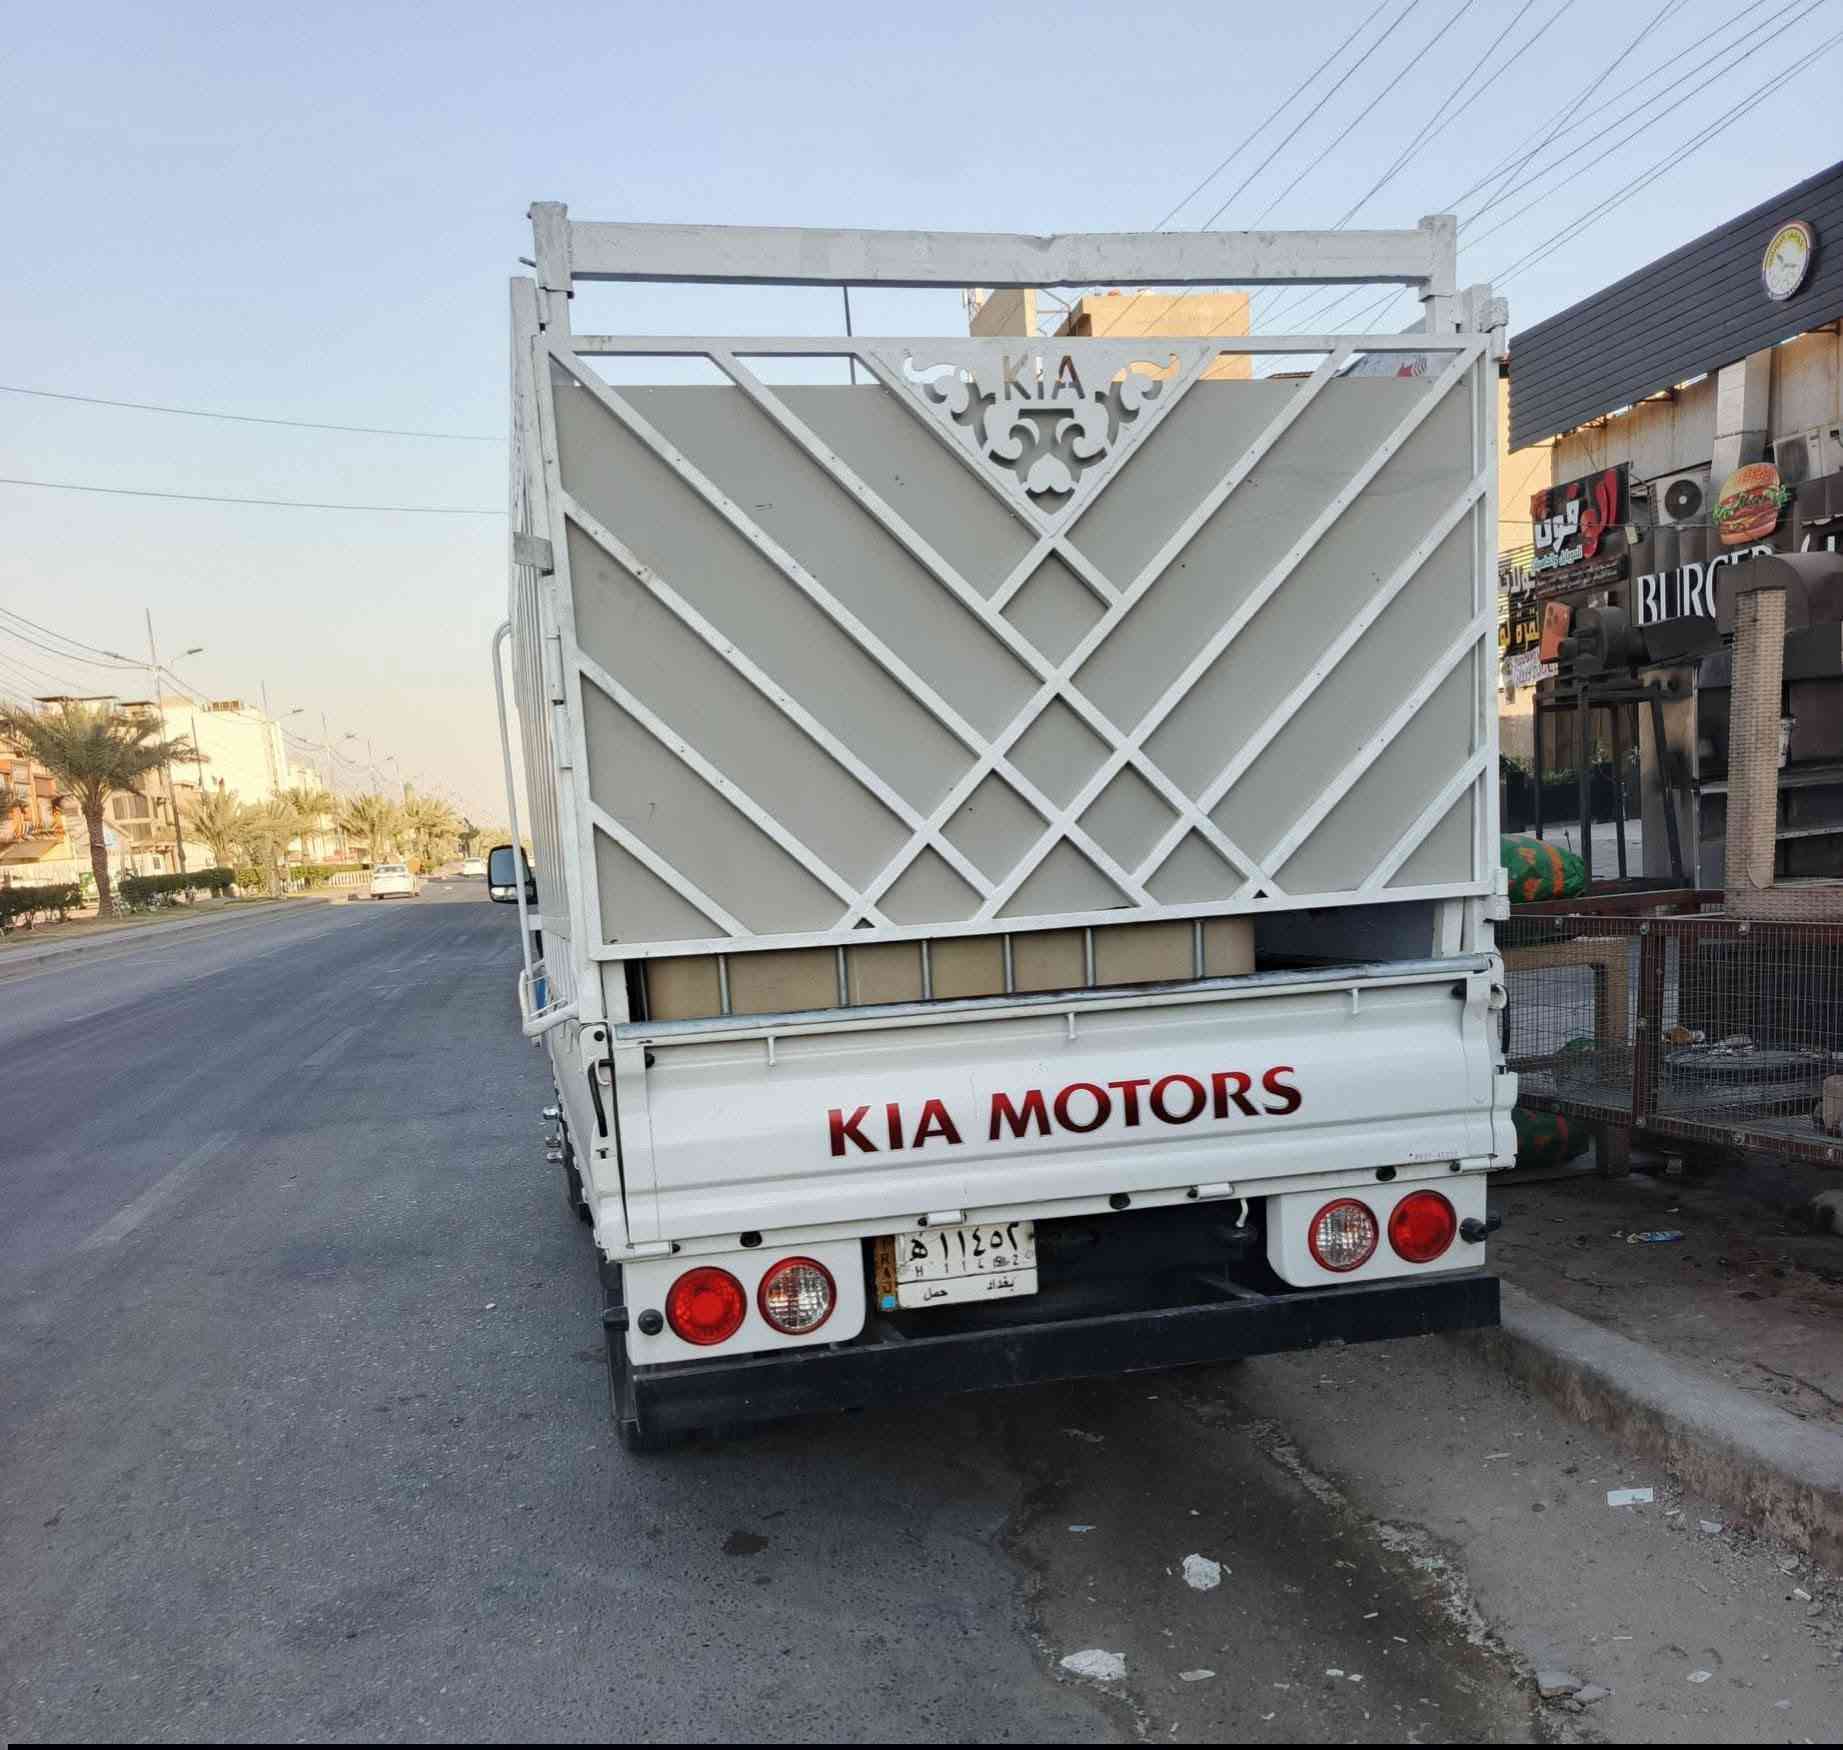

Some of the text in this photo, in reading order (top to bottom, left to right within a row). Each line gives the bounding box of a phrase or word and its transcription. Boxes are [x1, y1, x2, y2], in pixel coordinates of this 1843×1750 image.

[1002, 355, 1086, 400] KIA
[1637, 545, 1774, 626] BUR
[827, 1065, 1303, 1157] KIA MOTORS
[923, 1275, 1015, 1302] حمل بغداد
